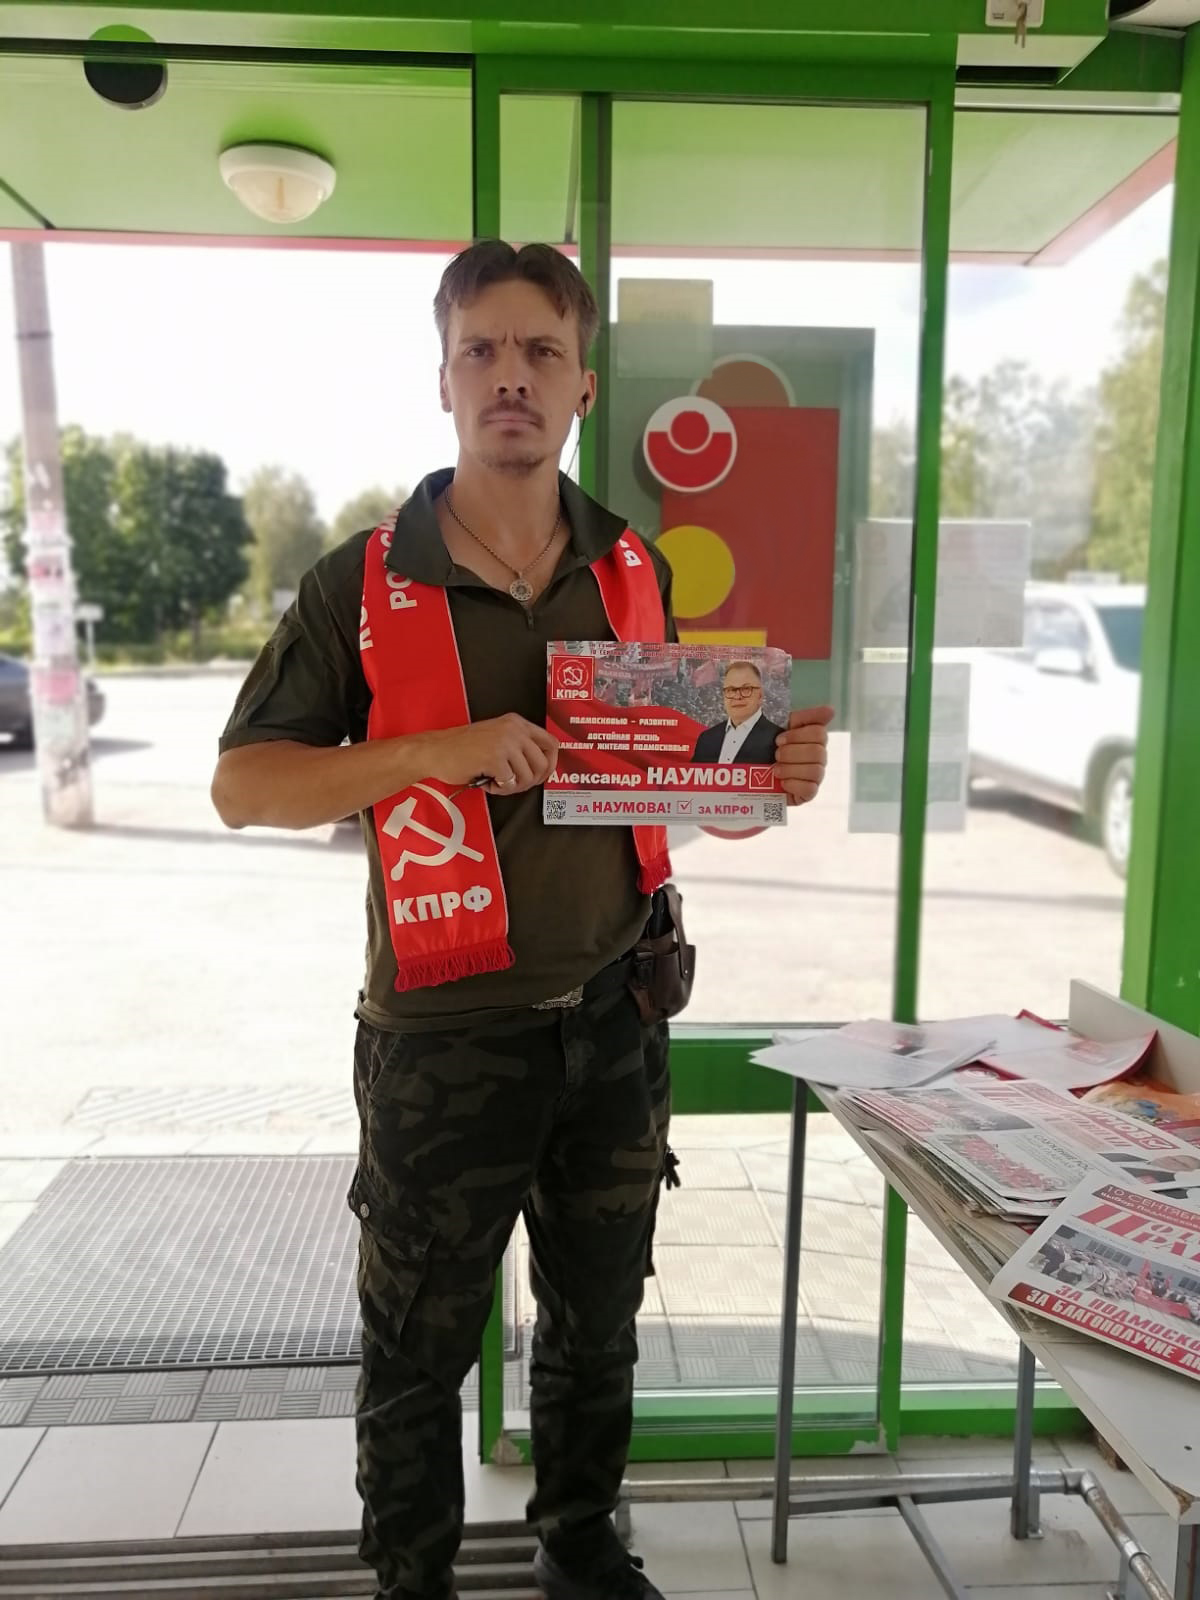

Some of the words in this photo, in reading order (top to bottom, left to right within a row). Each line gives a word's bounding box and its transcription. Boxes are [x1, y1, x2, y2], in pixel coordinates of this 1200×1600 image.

[556, 689, 589, 699] КПРФ
[587, 731, 631, 741] ДОСТОЙНАЯ
[633, 734, 660, 742] ЖИЗНЬ
[547, 770, 642, 787] Александр
[647, 766, 747, 786] НАУМОВ
[592, 801, 671, 814] НАУМОВА!
[714, 805, 754, 815] КПРФ!
[393, 885, 492, 925] КПРФ
[1106, 1185, 1125, 1197] 10
[1055, 1284, 1083, 1302] ЗА
[1026, 1289, 1048, 1307] ЗА
[1052, 1300, 1178, 1359] БЛАГОПОЛУЧИЕ
